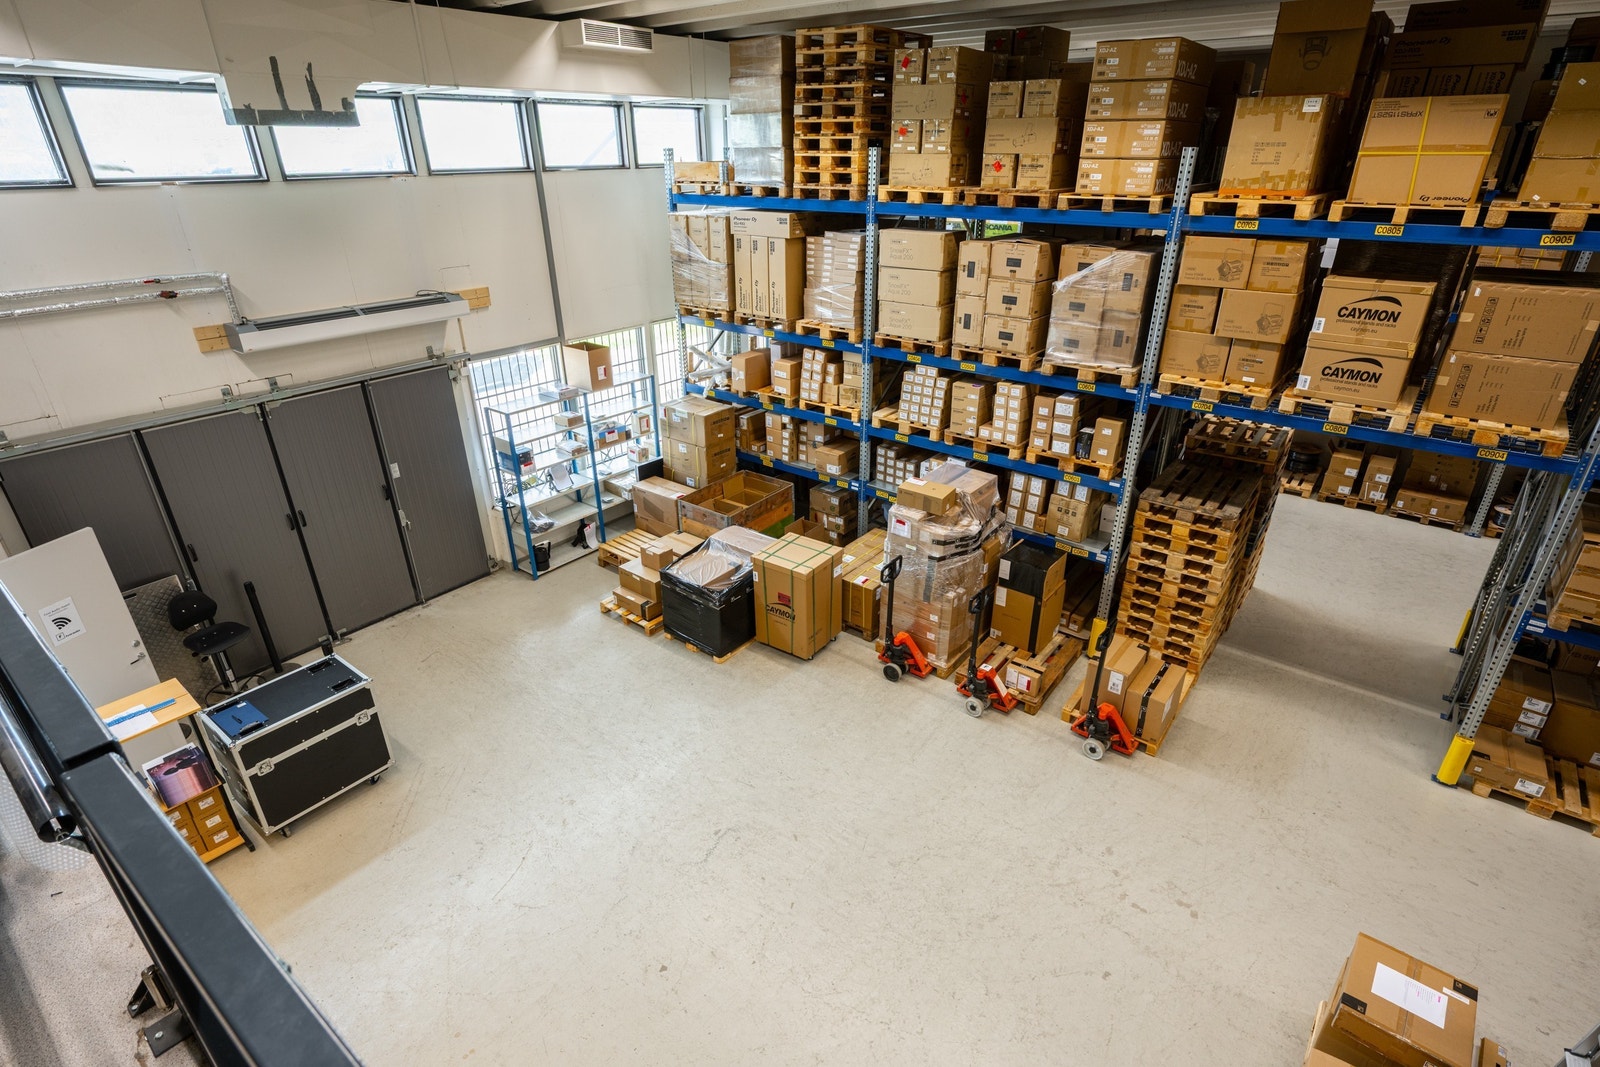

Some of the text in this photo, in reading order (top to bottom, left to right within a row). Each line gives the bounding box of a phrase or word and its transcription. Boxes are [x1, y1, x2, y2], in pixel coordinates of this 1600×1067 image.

[1176, 60, 1198, 80] XDJ-AZ
[1167, 101, 1189, 119] XDJ-AZ
[1432, 195, 1471, 203] Pioneer
[1236, 220, 1257, 230] C0705
[1377, 226, 1402, 235] C0805
[1543, 236, 1573, 245] C0905
[1337, 306, 1401, 322] CAYMON
[1350, 326, 1378, 334] caymon.eu
[1321, 366, 1382, 383] CAYMON
[1079, 382, 1094, 390] C0604
[1194, 402, 1212, 410] C0704
[1324, 424, 1347, 434] C0804
[1479, 449, 1505, 460] C0904
